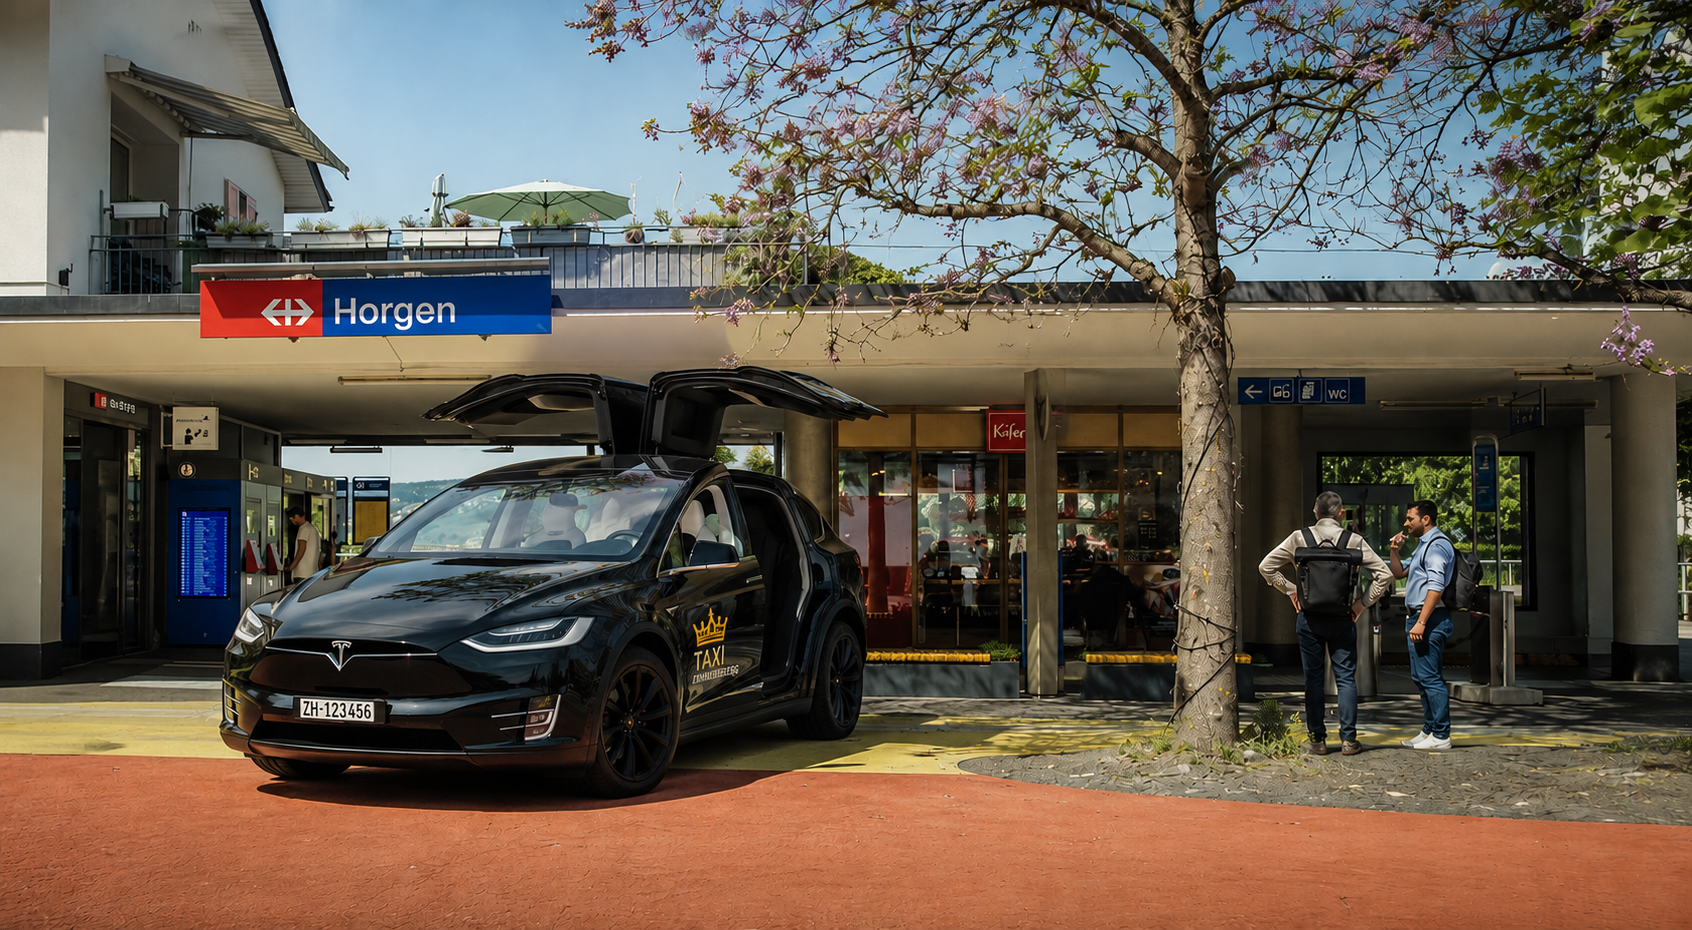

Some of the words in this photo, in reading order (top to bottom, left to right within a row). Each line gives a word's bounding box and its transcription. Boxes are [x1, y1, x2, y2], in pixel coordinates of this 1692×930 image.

[334, 297, 456, 331] Horgen
[1328, 389, 1347, 400] WC
[694, 644, 725, 671] TAXI
[303, 701, 371, 719] ZH-123456
